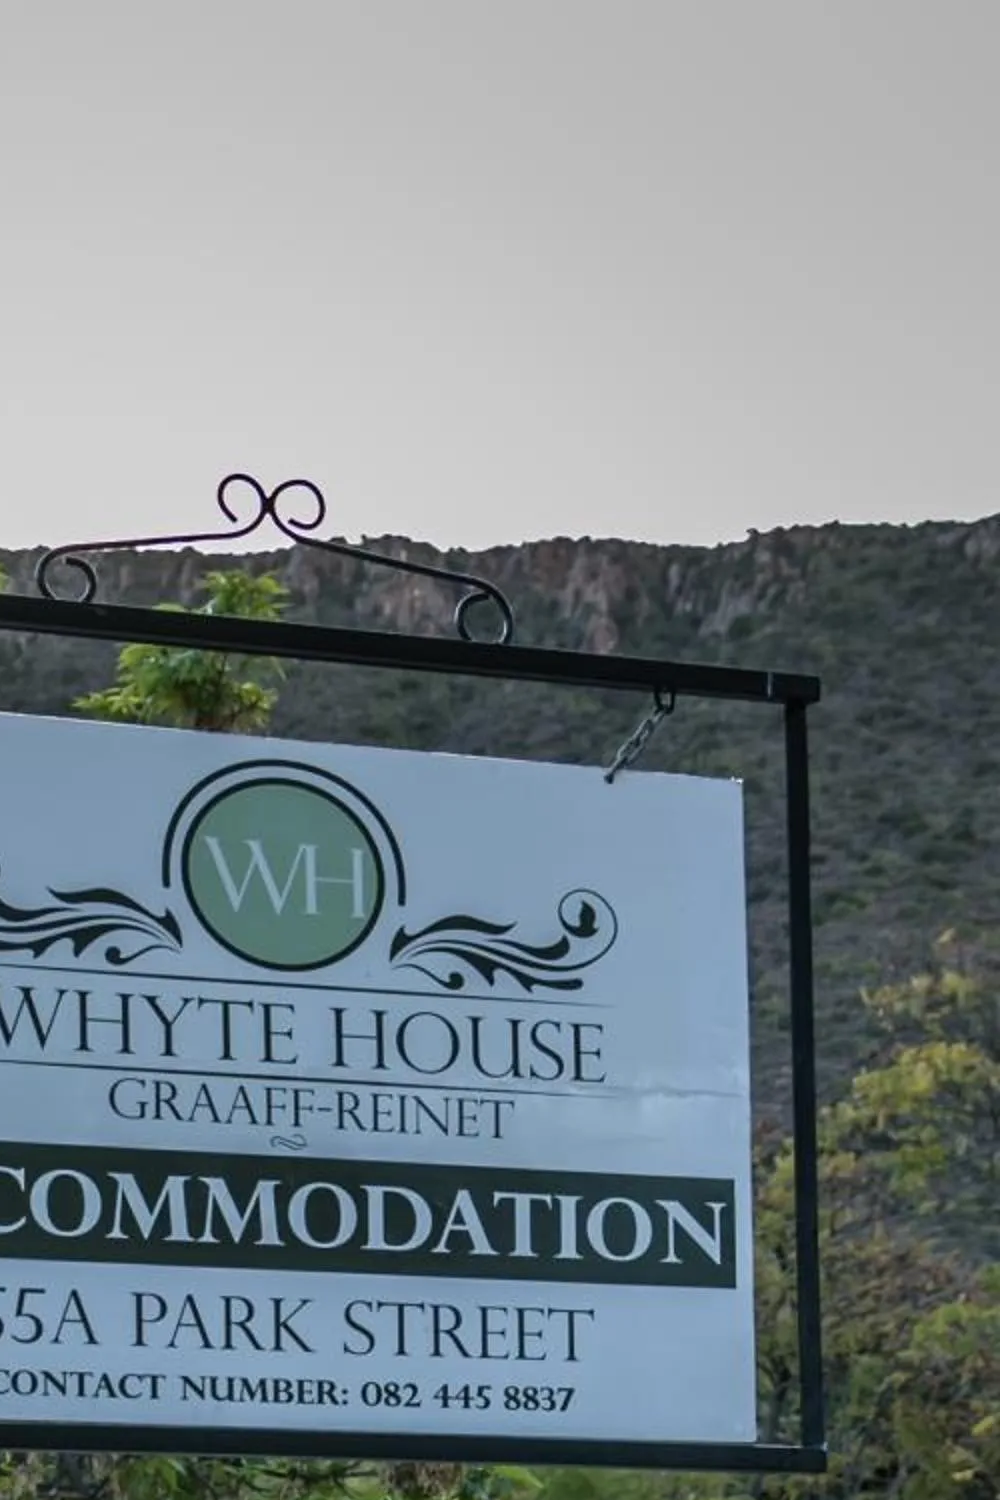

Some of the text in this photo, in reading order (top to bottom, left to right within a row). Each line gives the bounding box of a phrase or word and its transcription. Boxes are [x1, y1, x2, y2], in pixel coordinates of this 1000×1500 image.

[203, 834, 367, 920] WH
[330, 1008, 607, 1085] HOUSE
[108, 1076, 516, 1140] GRAAFF-REINET
[130, 1291, 312, 1355] PARK
[343, 1299, 595, 1363] STREET
[179, 1374, 350, 1409] NUMBER:
[360, 1381, 423, 1411] 082
[433, 1383, 492, 1412] 445
[502, 1385, 575, 1414] 8837
